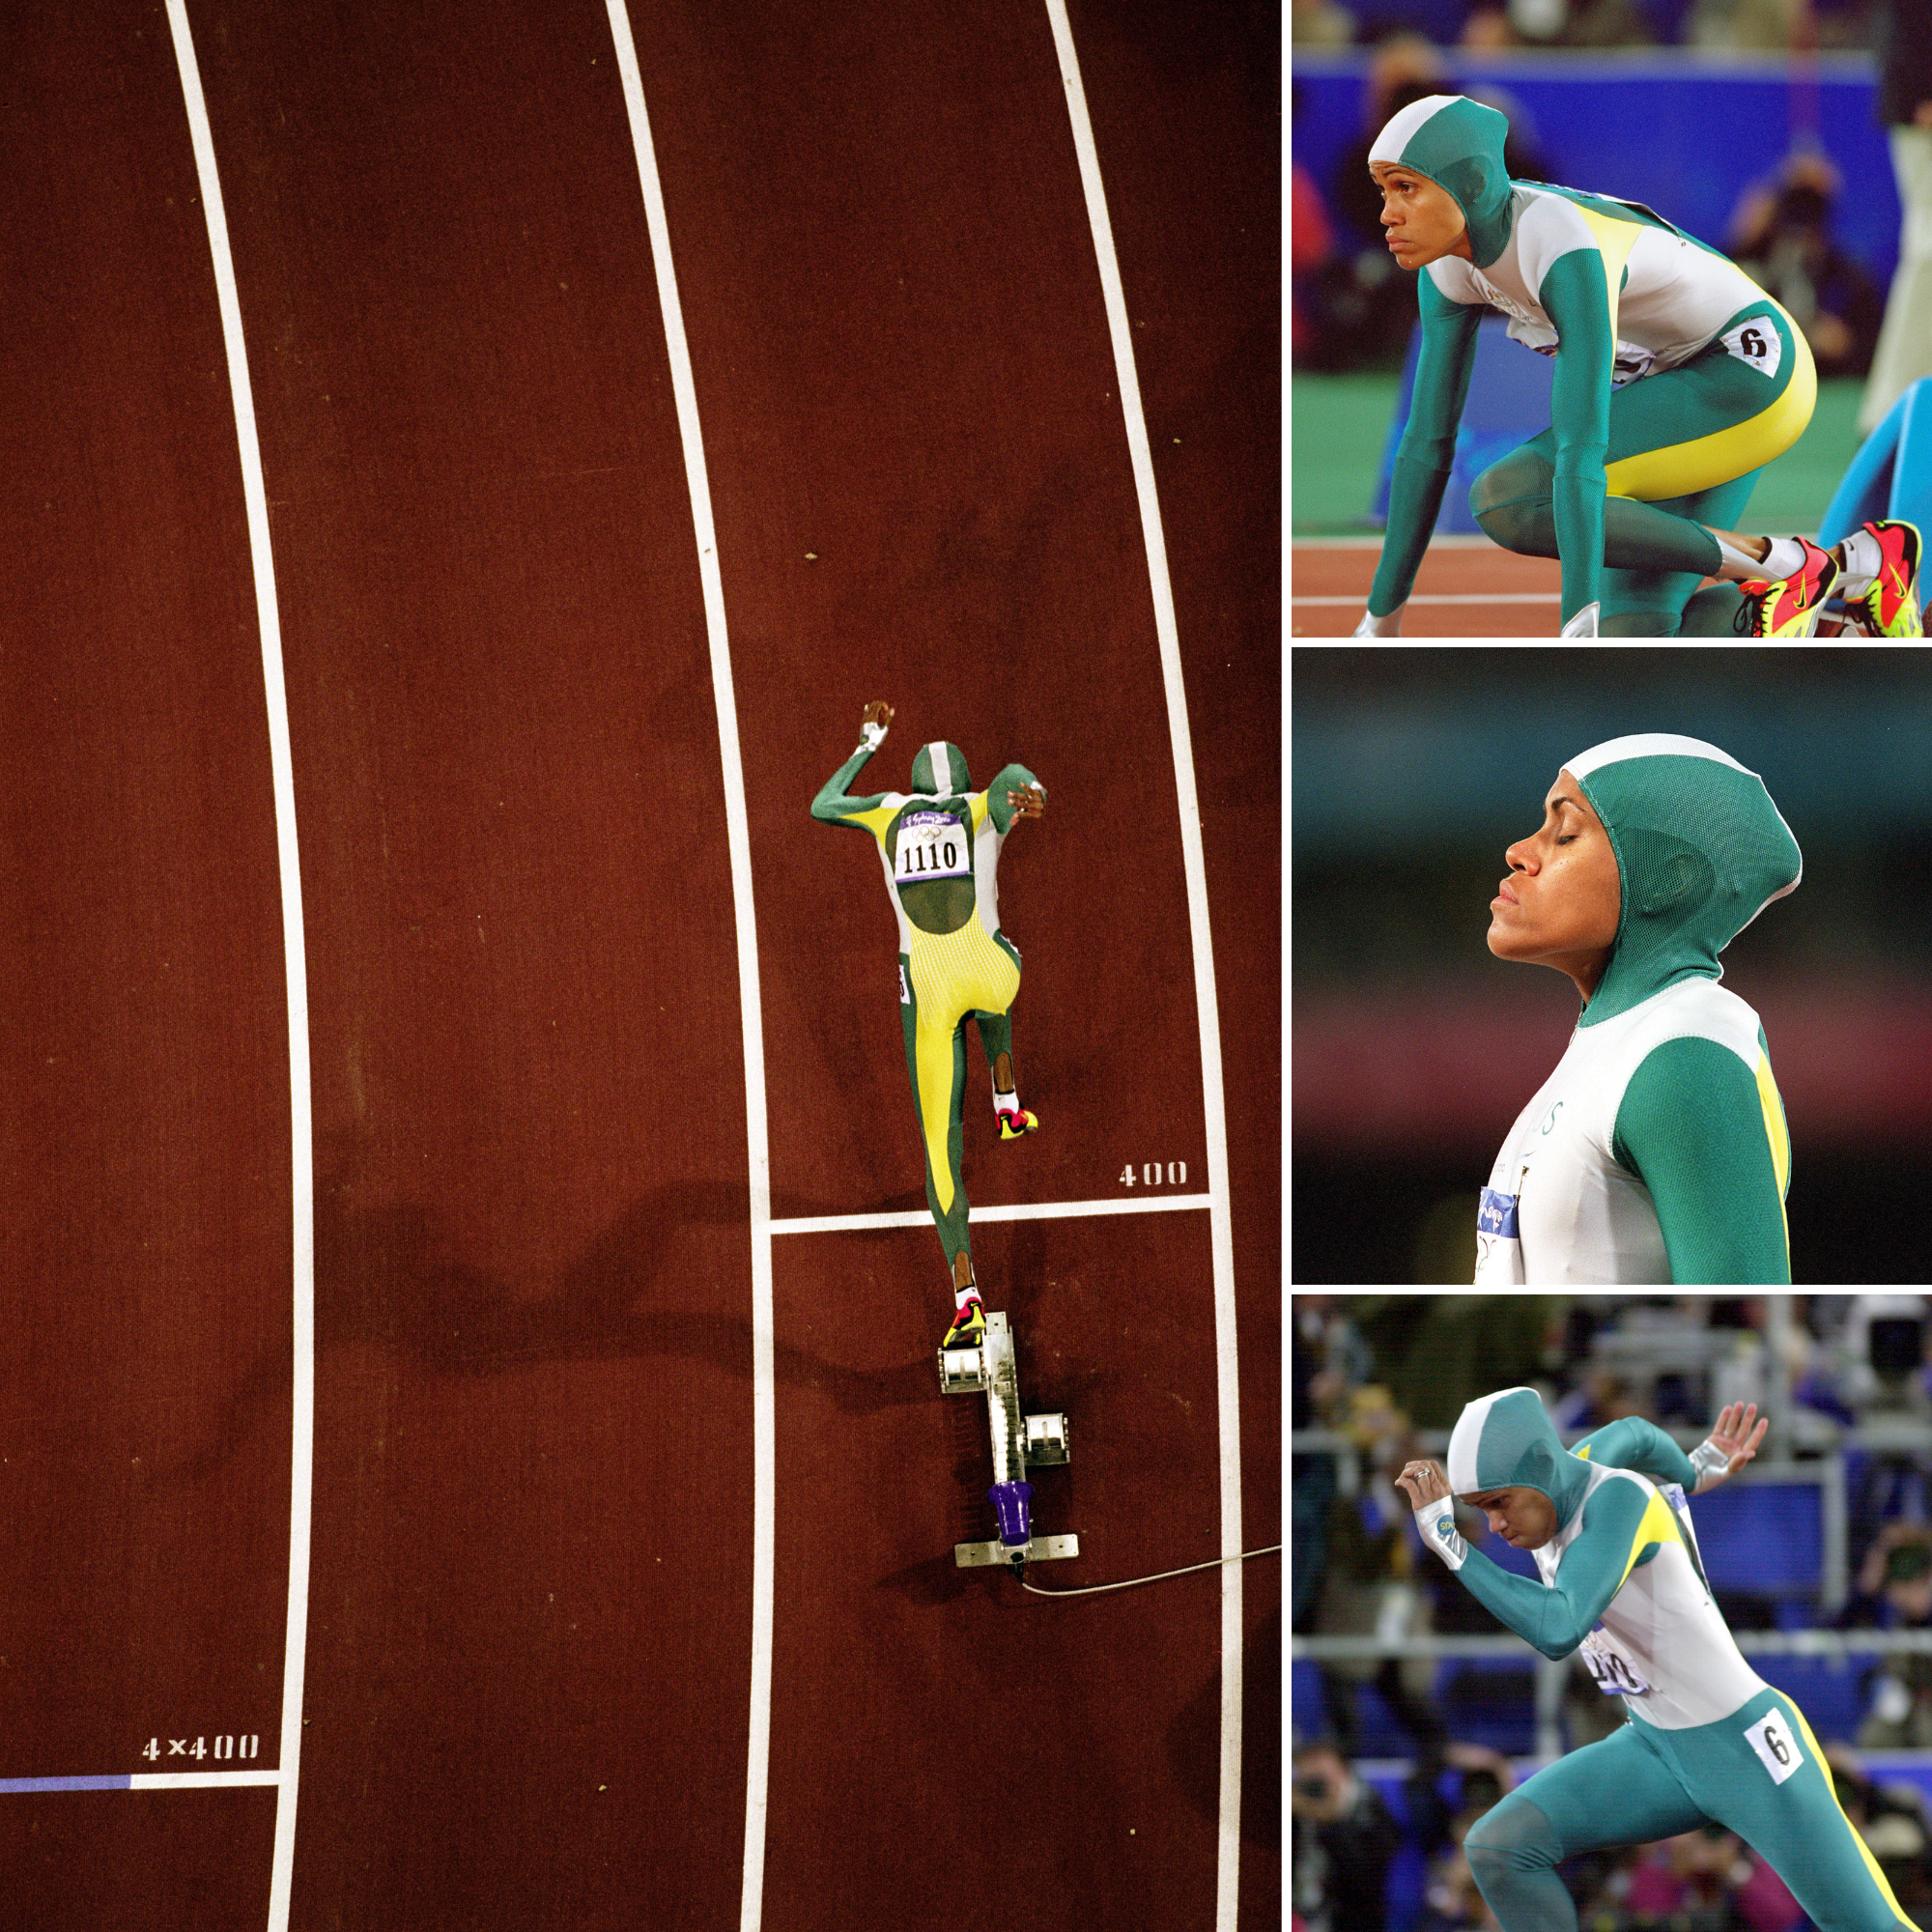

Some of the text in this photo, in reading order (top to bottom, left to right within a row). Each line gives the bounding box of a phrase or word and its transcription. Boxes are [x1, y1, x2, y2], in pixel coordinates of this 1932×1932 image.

[1740, 327, 1767, 357] 6
[912, 811, 935, 826] Sydney
[904, 841, 957, 874] 1110
[1119, 1161, 1187, 1187] 400
[1764, 1725, 1790, 1766] 6
